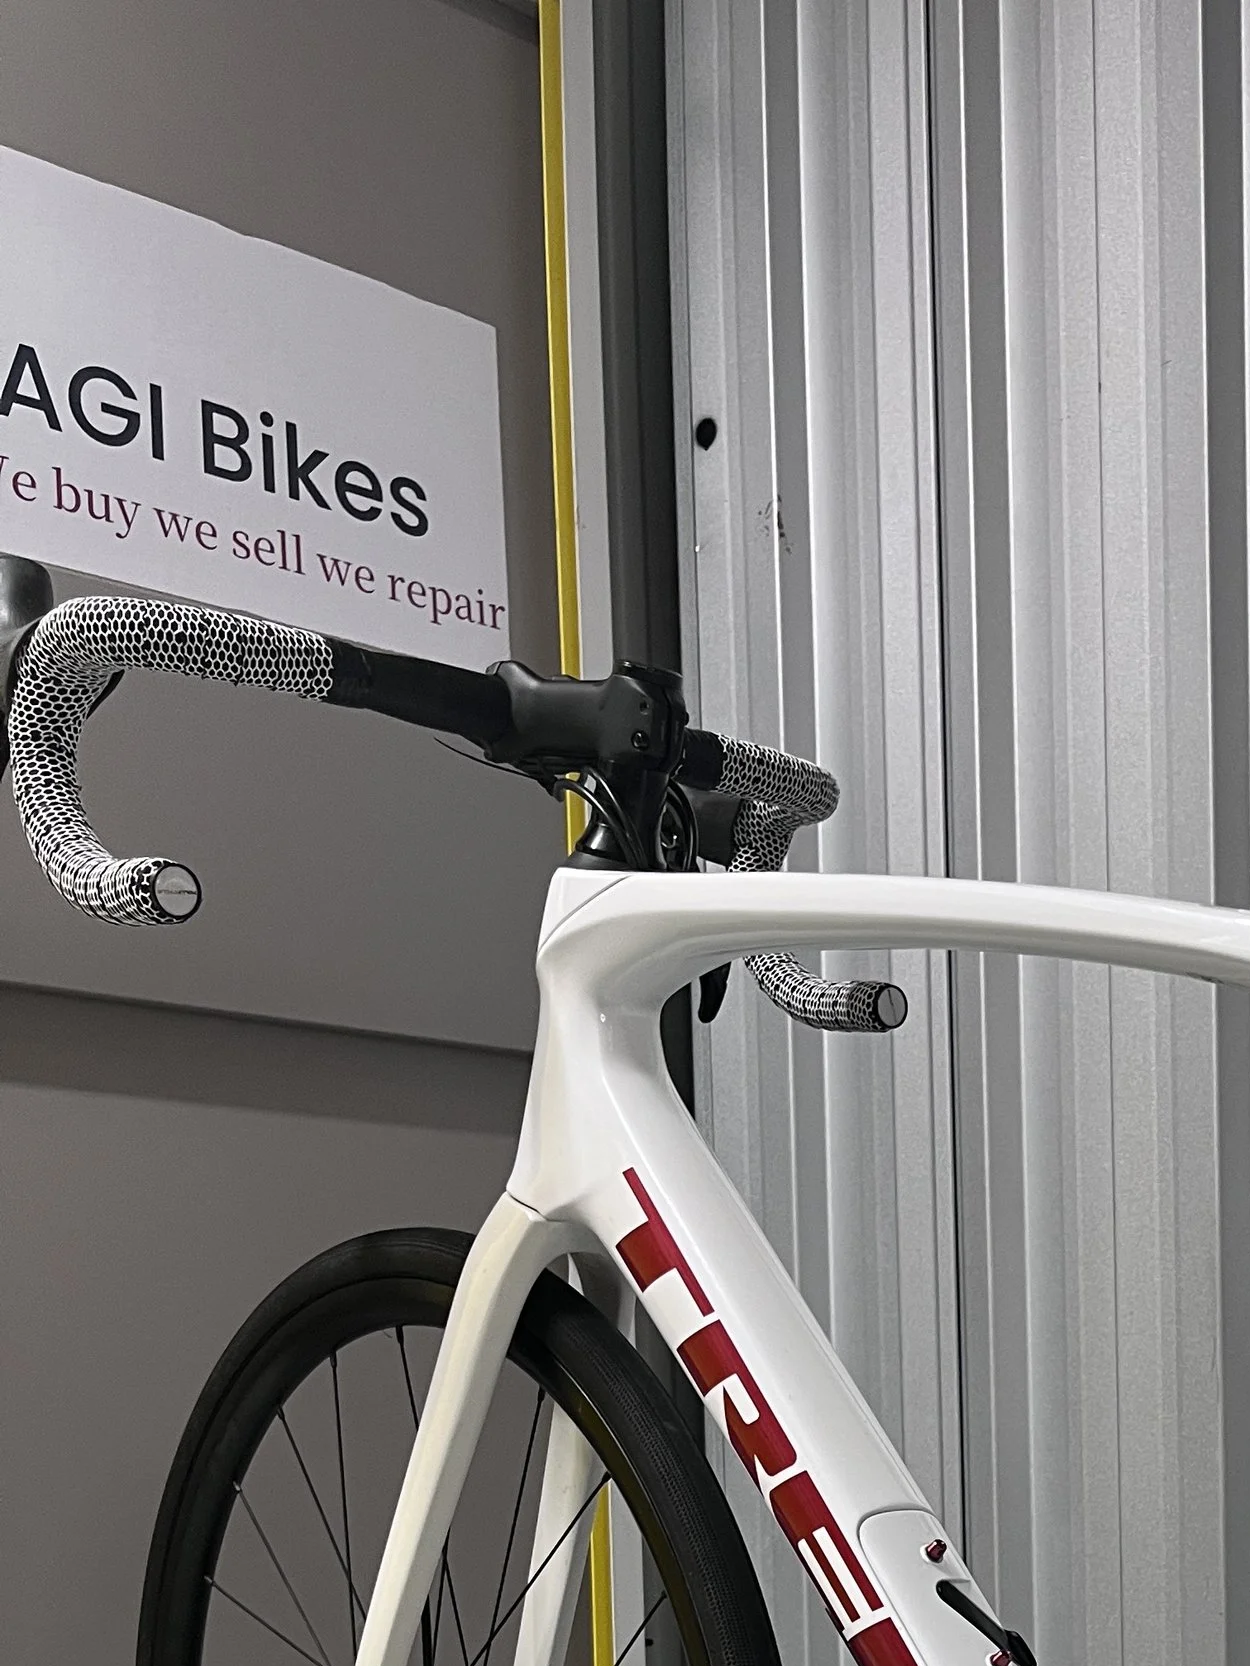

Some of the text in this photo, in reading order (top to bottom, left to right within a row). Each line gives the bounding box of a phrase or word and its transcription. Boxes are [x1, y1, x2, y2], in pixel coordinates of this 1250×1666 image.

[0, 343, 429, 537] AGI Bikes
[52, 466, 142, 539] buy
[153, 507, 218, 550] we
[232, 529, 306, 575] sell
[316, 553, 375, 594] we
[387, 574, 506, 630] repair
